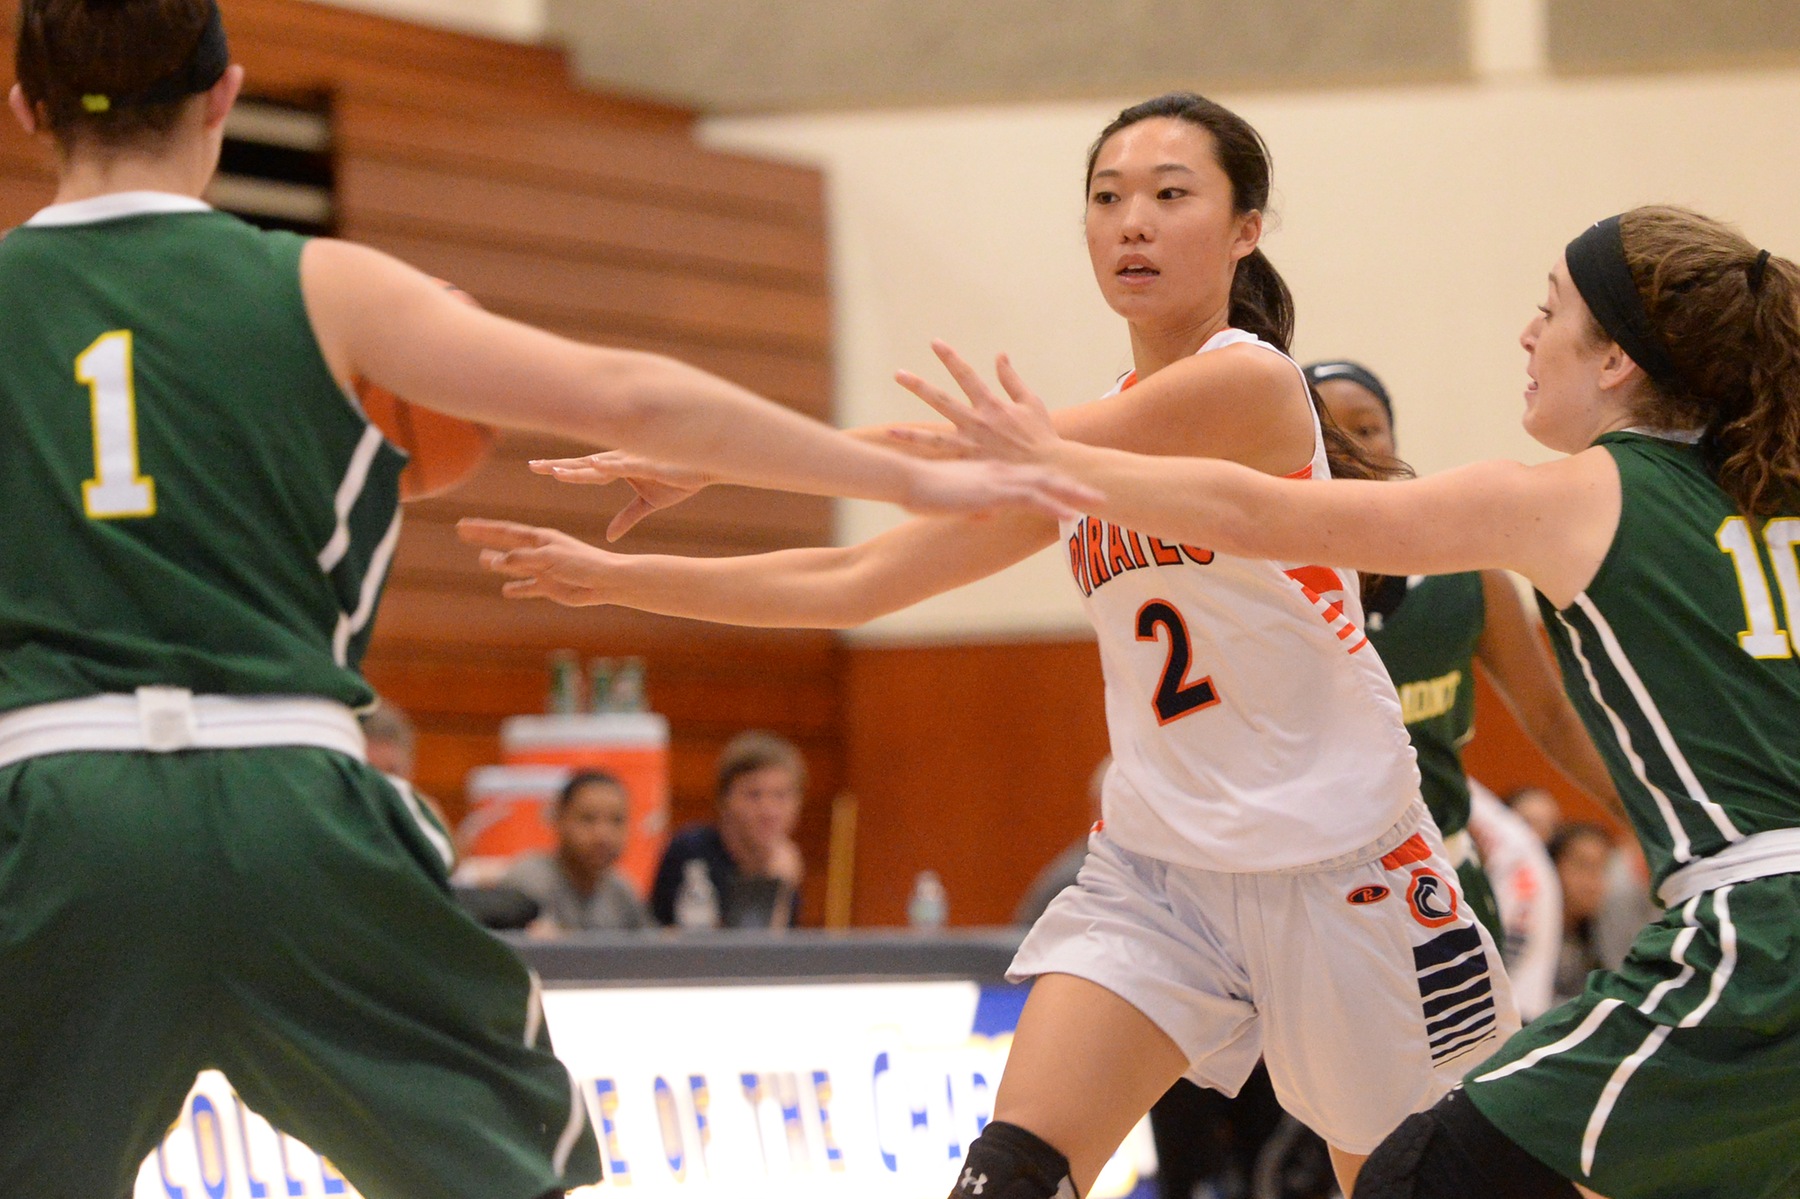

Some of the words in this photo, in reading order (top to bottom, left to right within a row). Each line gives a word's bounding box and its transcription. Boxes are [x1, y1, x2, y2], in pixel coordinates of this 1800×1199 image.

[74, 329, 157, 519] 1
[1135, 598, 1222, 727] 2
[652, 1073, 712, 1184] OF
